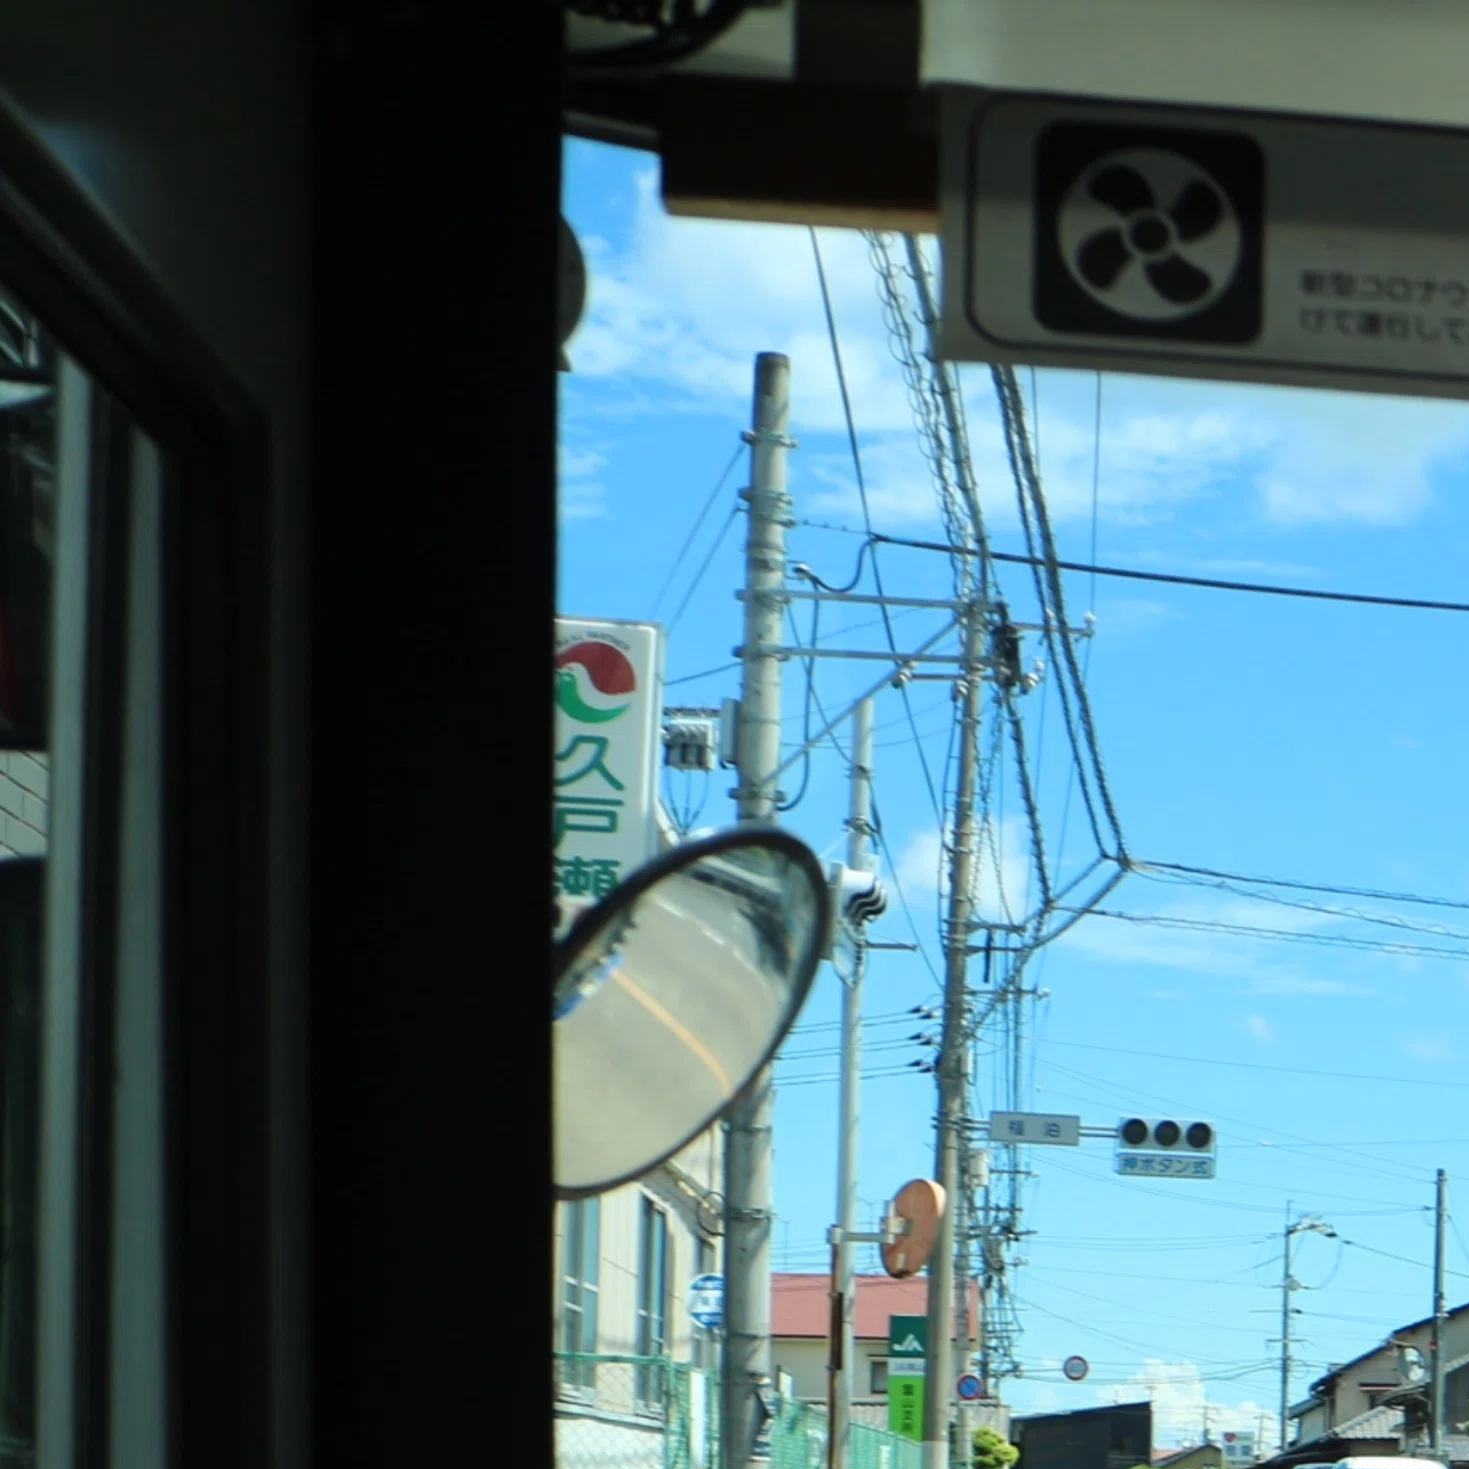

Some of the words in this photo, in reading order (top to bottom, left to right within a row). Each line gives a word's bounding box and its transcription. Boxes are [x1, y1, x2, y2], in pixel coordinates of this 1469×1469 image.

[1121, 1156, 1209, 1176] 押ボタン式
